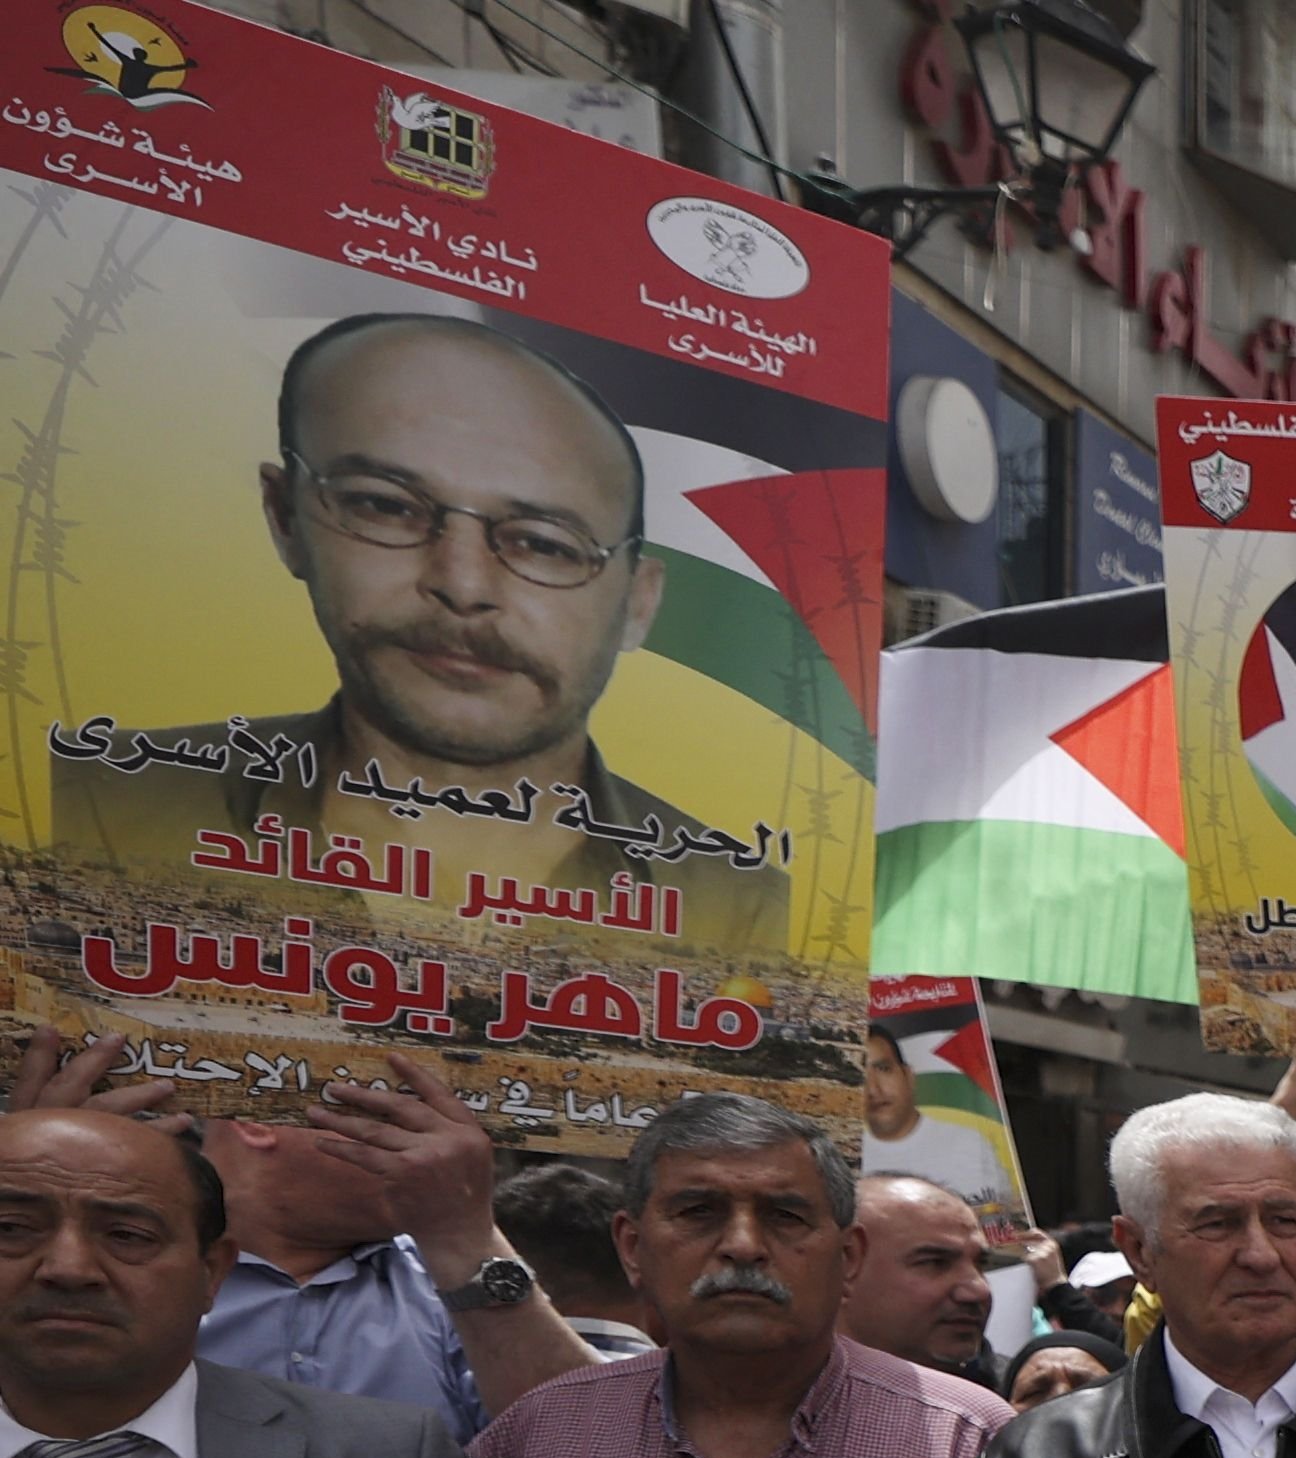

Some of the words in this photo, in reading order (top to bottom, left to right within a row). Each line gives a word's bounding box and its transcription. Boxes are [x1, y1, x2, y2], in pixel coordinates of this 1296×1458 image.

[2, 97, 124, 148] شؤون
[43, 152, 202, 206] الأسرى
[131, 128, 243, 183] هيئة
[325, 201, 440, 240] الأسير
[342, 239, 525, 300] الفلسطيني
[448, 233, 538, 271] نادي
[640, 283, 727, 327] العليا
[730, 309, 816, 356] الهيئة
[668, 333, 786, 378] للأسرى
[48, 714, 315, 789] الأسرى
[337, 761, 533, 825] لعميد
[552, 783, 795, 870] الحرية
[191, 813, 431, 902] القائد
[458, 869, 682, 937] الأسير
[81, 917, 452, 1036] يونس
[486, 967, 763, 1051] ماهر
[498, 1075, 554, 1127] في
